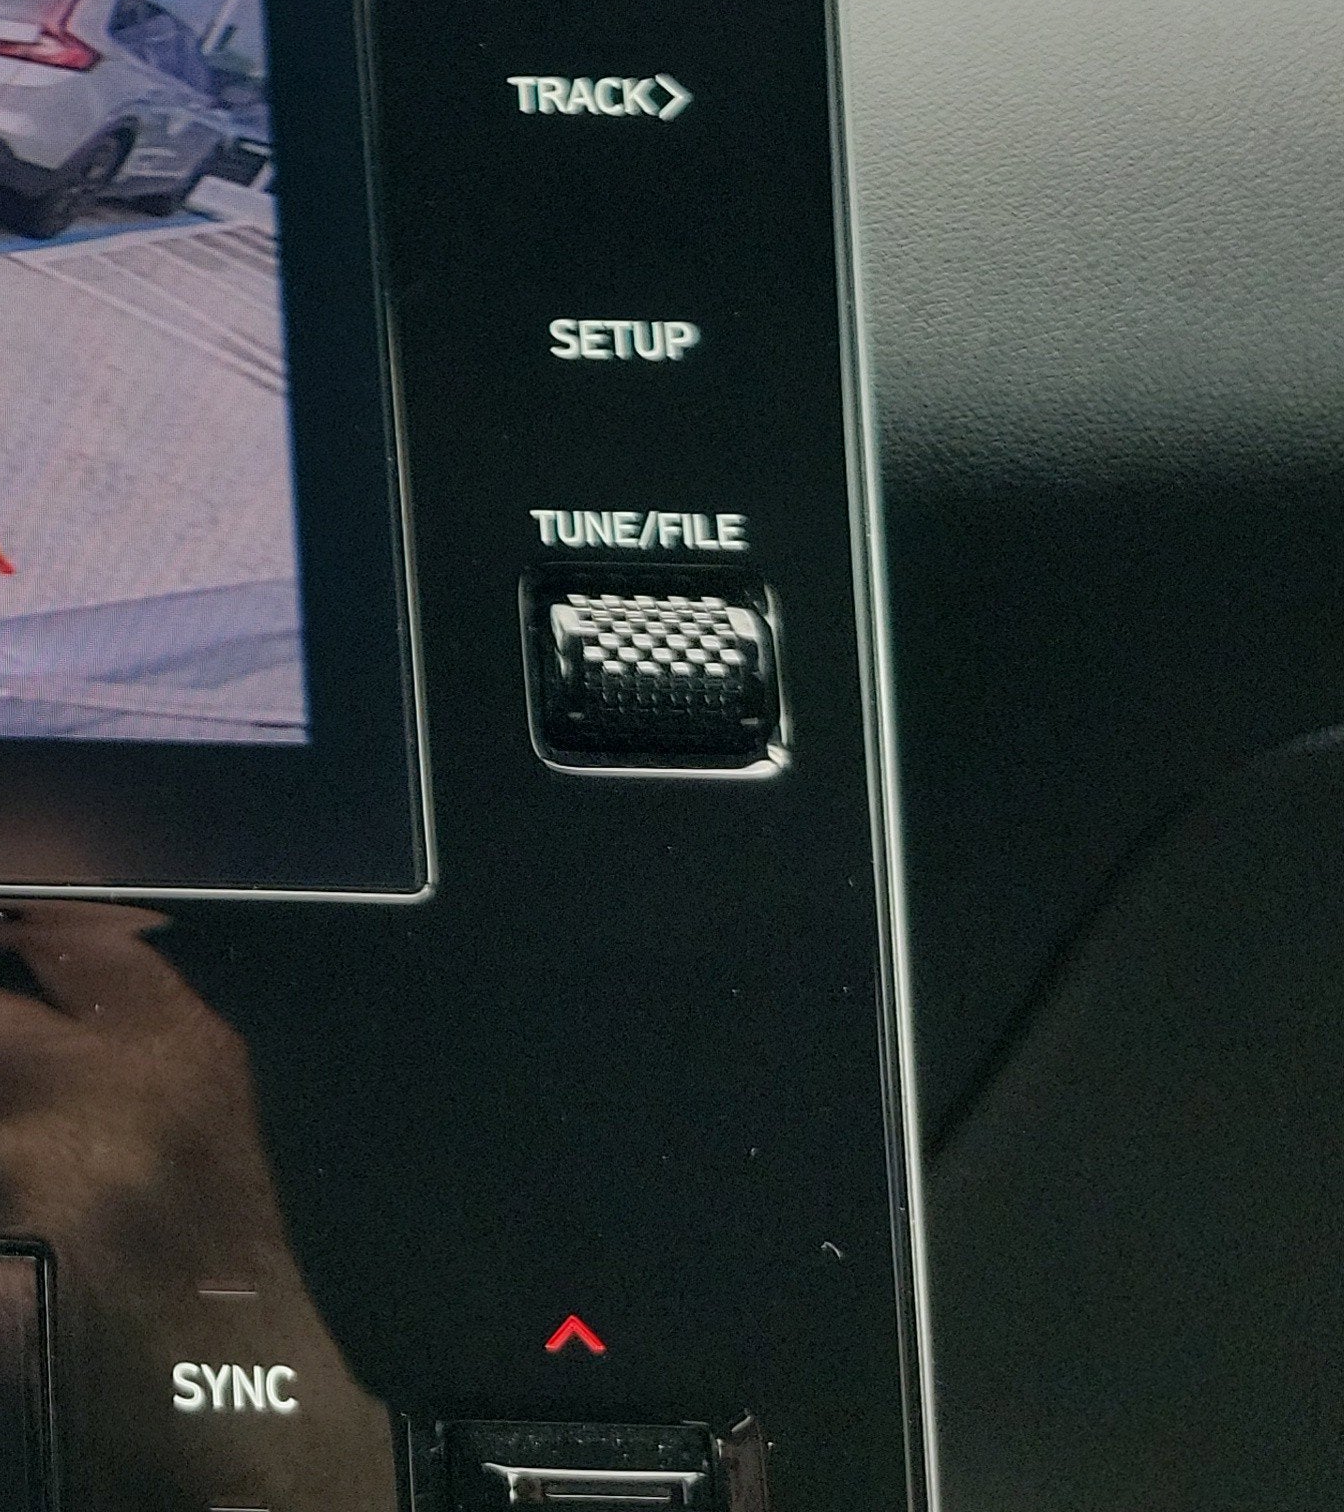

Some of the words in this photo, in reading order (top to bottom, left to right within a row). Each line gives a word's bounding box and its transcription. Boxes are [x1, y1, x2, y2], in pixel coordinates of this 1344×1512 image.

[506, 75, 658, 117] TRACK
[547, 318, 702, 362] SETUP
[528, 509, 751, 551] TUNE/FILE
[172, 1360, 302, 1418] SYNC
